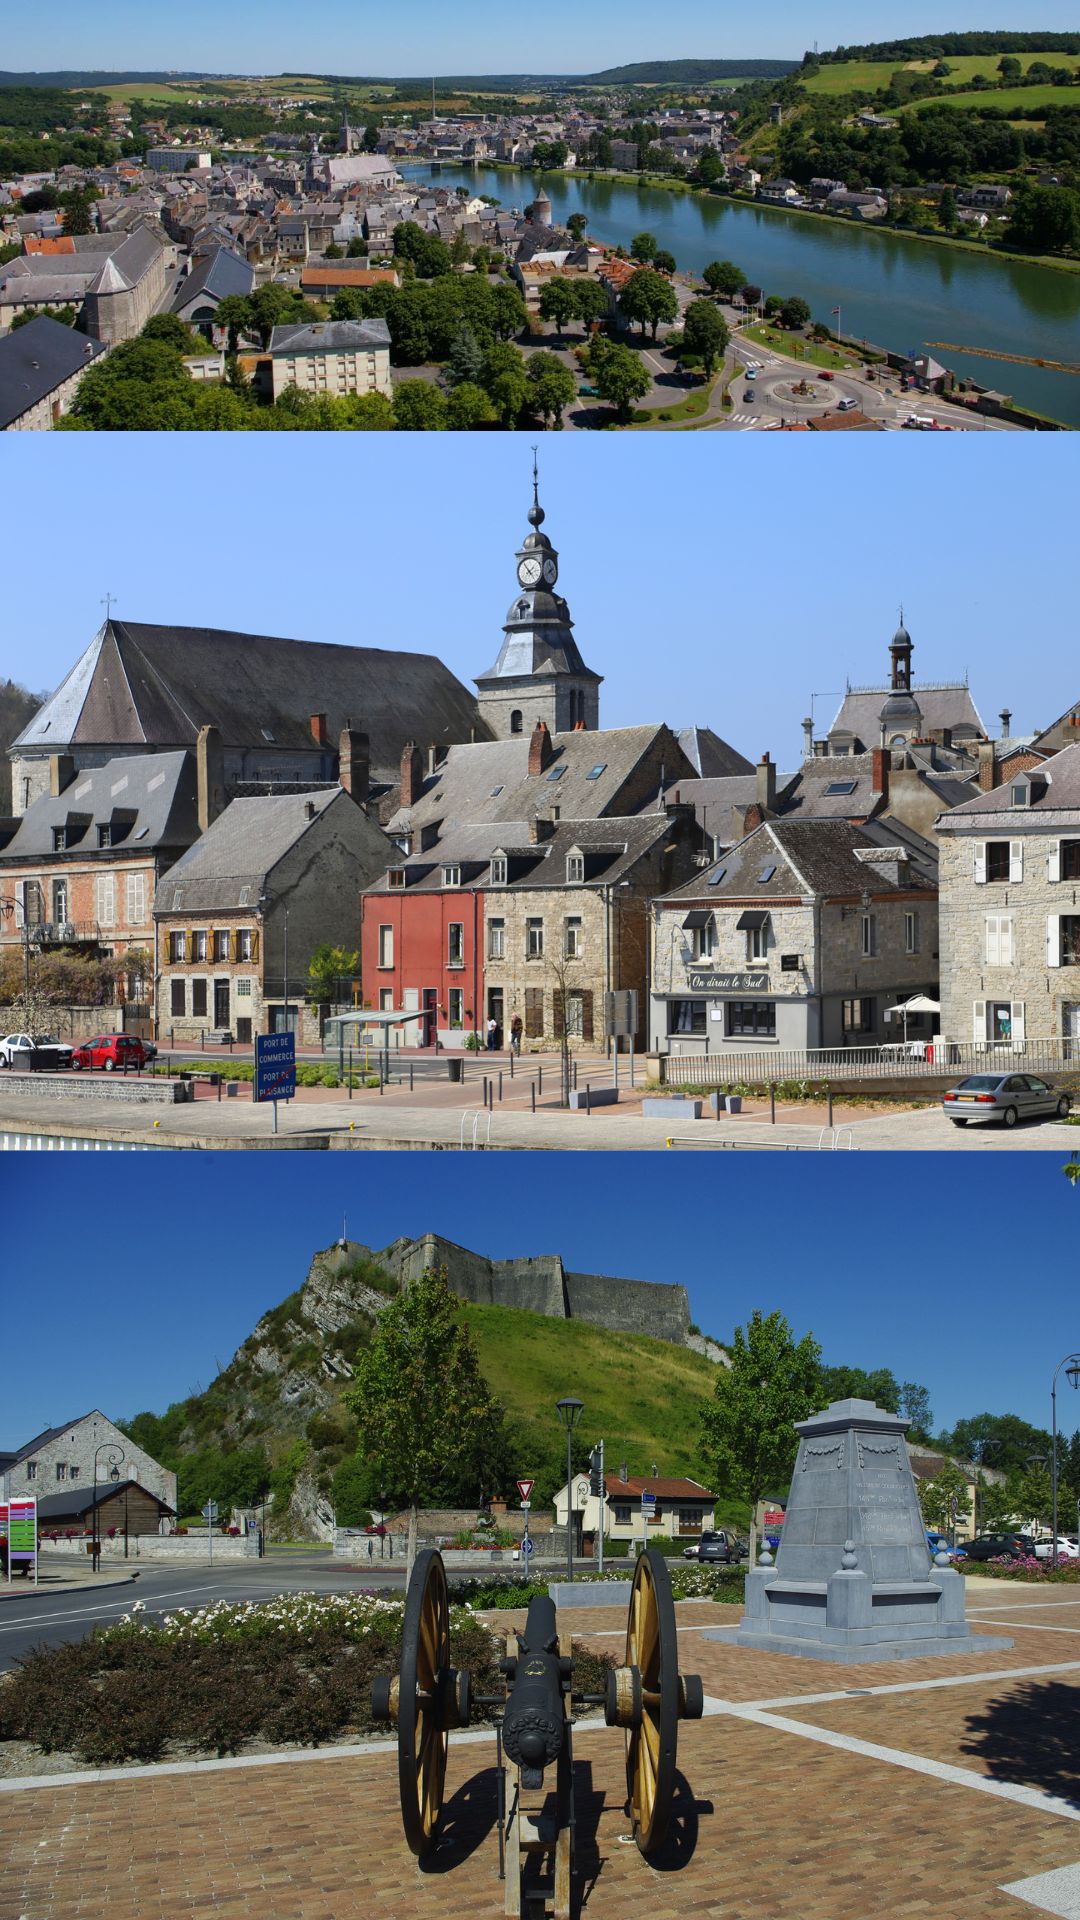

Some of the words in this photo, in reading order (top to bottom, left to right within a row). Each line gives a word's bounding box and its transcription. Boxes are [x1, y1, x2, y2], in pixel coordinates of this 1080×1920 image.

[692, 976, 705, 987] On
[707, 975, 731, 987] dirait
[732, 976, 740, 987] le
[743, 975, 764, 990] Sud
[264, 1039, 279, 1048] PORT
[281, 1038, 289, 1046] DE
[260, 1052, 294, 1063] COMMERCE
[264, 1072, 279, 1081] PORT
[260, 1085, 294, 1095] PLAISANCE
